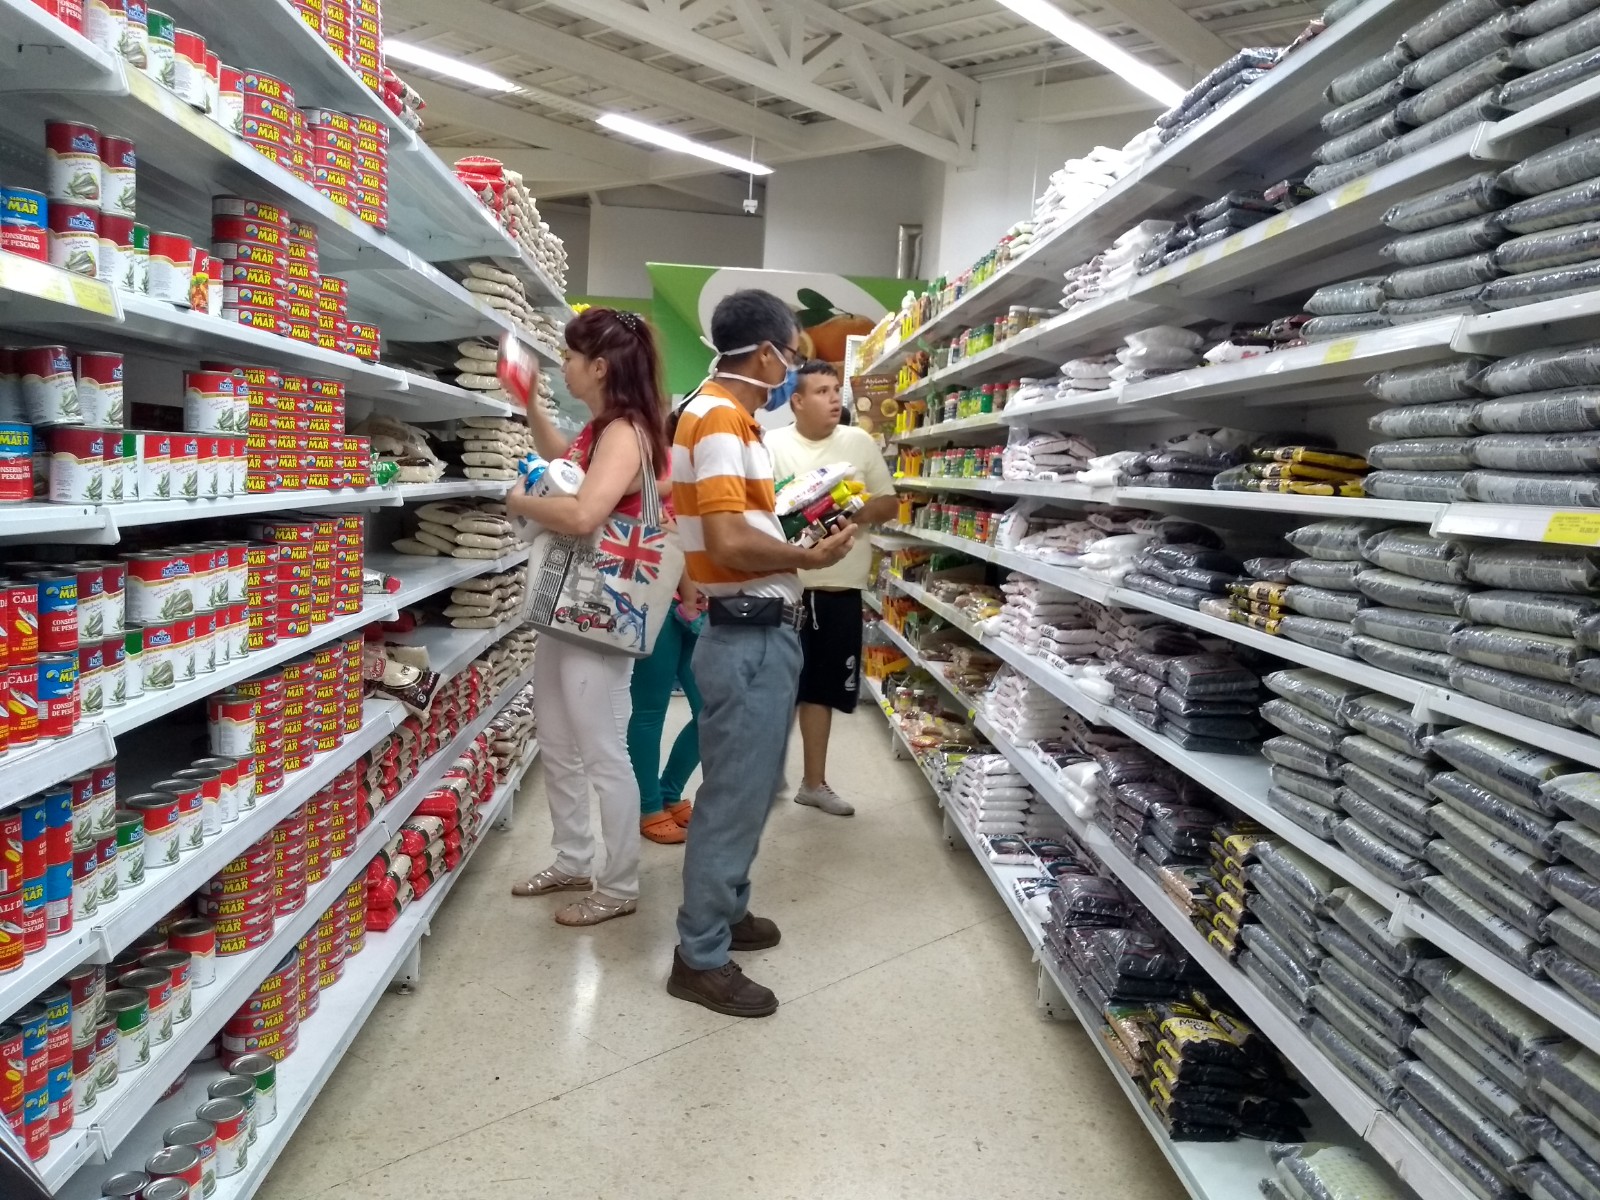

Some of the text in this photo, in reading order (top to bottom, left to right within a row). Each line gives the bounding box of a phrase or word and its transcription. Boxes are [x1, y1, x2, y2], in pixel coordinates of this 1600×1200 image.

[361, 1, 376, 15] MAR
[328, 8, 344, 22] MAR
[363, 20, 376, 34] MAR
[328, 27, 344, 40] MAR
[360, 38, 375, 51] MAR
[361, 56, 376, 69] MAR
[362, 74, 377, 89] MAR
[258, 82, 280, 97] MAR
[271, 108, 288, 123] MAR
[331, 118, 348, 131] MAR
[359, 121, 377, 134] MAR
[258, 126, 280, 142] MAR
[73, 138, 97, 151] INCOSA
[336, 138, 352, 151] MAR
[360, 139, 377, 152] MAR
[335, 156, 351, 170] MAR
[364, 158, 379, 171] MAR
[327, 173, 346, 187] MAR
[363, 175, 378, 188] MAR
[330, 193, 348, 207] MAR
[364, 193, 379, 207] MAR
[8, 201, 38, 215] MAR
[258, 208, 278, 223] MAR
[360, 210, 377, 223] MAR
[68, 218, 95, 231] INCOSA
[0, 233, 38, 242] CONSERVAS
[258, 231, 278, 244] MAR
[11, 239, 41, 250] PESCADO
[251, 250, 274, 265] MAR
[290, 266, 308, 278] MAR
[247, 271, 271, 285] MAR
[323, 282, 339, 292] MAR
[298, 288, 313, 300] MAR
[252, 294, 274, 307] MAR
[320, 300, 337, 311] MAR
[291, 306, 310, 318] MAR
[252, 315, 274, 328] MAR
[292, 328, 310, 339] MAR
[361, 329, 374, 340] MAR
[356, 346, 372, 356] MAR
[284, 381, 300, 391] MAR
[322, 386, 337, 396] MAR
[278, 400, 295, 411] MAR
[314, 404, 332, 413] MAR
[250, 416, 268, 427] MAR
[277, 418, 295, 429] MAR
[310, 422, 330, 431] MAR
[248, 437, 266, 448] MAR
[278, 439, 297, 448] MAR
[308, 440, 329, 449] MAR
[279, 458, 297, 467] MAR
[316, 459, 334, 468] MAR
[247, 480, 266, 490] MAR
[283, 478, 299, 487] MAR
[309, 477, 328, 486] MAR
[352, 476, 365, 484] MAR
[345, 519, 358, 529] MAR
[275, 531, 298, 540] MAR
[319, 526, 332, 535] MAR
[347, 536, 358, 545] MAR
[314, 542, 329, 552] MAR
[248, 554, 265, 564] MAR
[292, 549, 307, 559] MAR
[345, 553, 358, 562] MAR
[315, 561, 330, 570] MAR
[248, 575, 260, 585] AR
[317, 578, 330, 587] MAR
[249, 595, 261, 605] AR
[316, 594, 330, 604] MAR
[345, 602, 358, 611] MAR
[312, 612, 326, 622] MAR
[150, 635, 171, 645] INCOSA
[348, 643, 360, 652] MAR
[316, 655, 330, 664] MAR
[349, 658, 360, 667] MAR
[323, 671, 337, 680] MAR
[287, 687, 304, 697] MAR
[317, 688, 333, 698] MAR
[53, 701, 74, 709] CONSE
[285, 705, 302, 716] MAR
[323, 704, 337, 714] MAR
[284, 723, 302, 733] MAR
[322, 722, 337, 732] MAR
[347, 722, 359, 731] MAR
[318, 739, 335, 749] MAR
[223, 862, 248, 874] MAR
[224, 882, 248, 893] MAR
[348, 883, 361, 894] MAR
[219, 902, 245, 914] MAR
[348, 899, 362, 908] MAR
[349, 914, 362, 923] MAR
[216, 922, 241, 933] MAR
[319, 927, 333, 937] MAR
[350, 929, 363, 938] MAR
[221, 941, 246, 952] MAR
[260, 980, 281, 992] MAR
[319, 975, 335, 986] MAR
[261, 999, 282, 1011] MAR
[264, 1015, 284, 1029] MAR
[258, 1034, 279, 1049] MAR
[32, 1052, 48, 1065] CONSE
